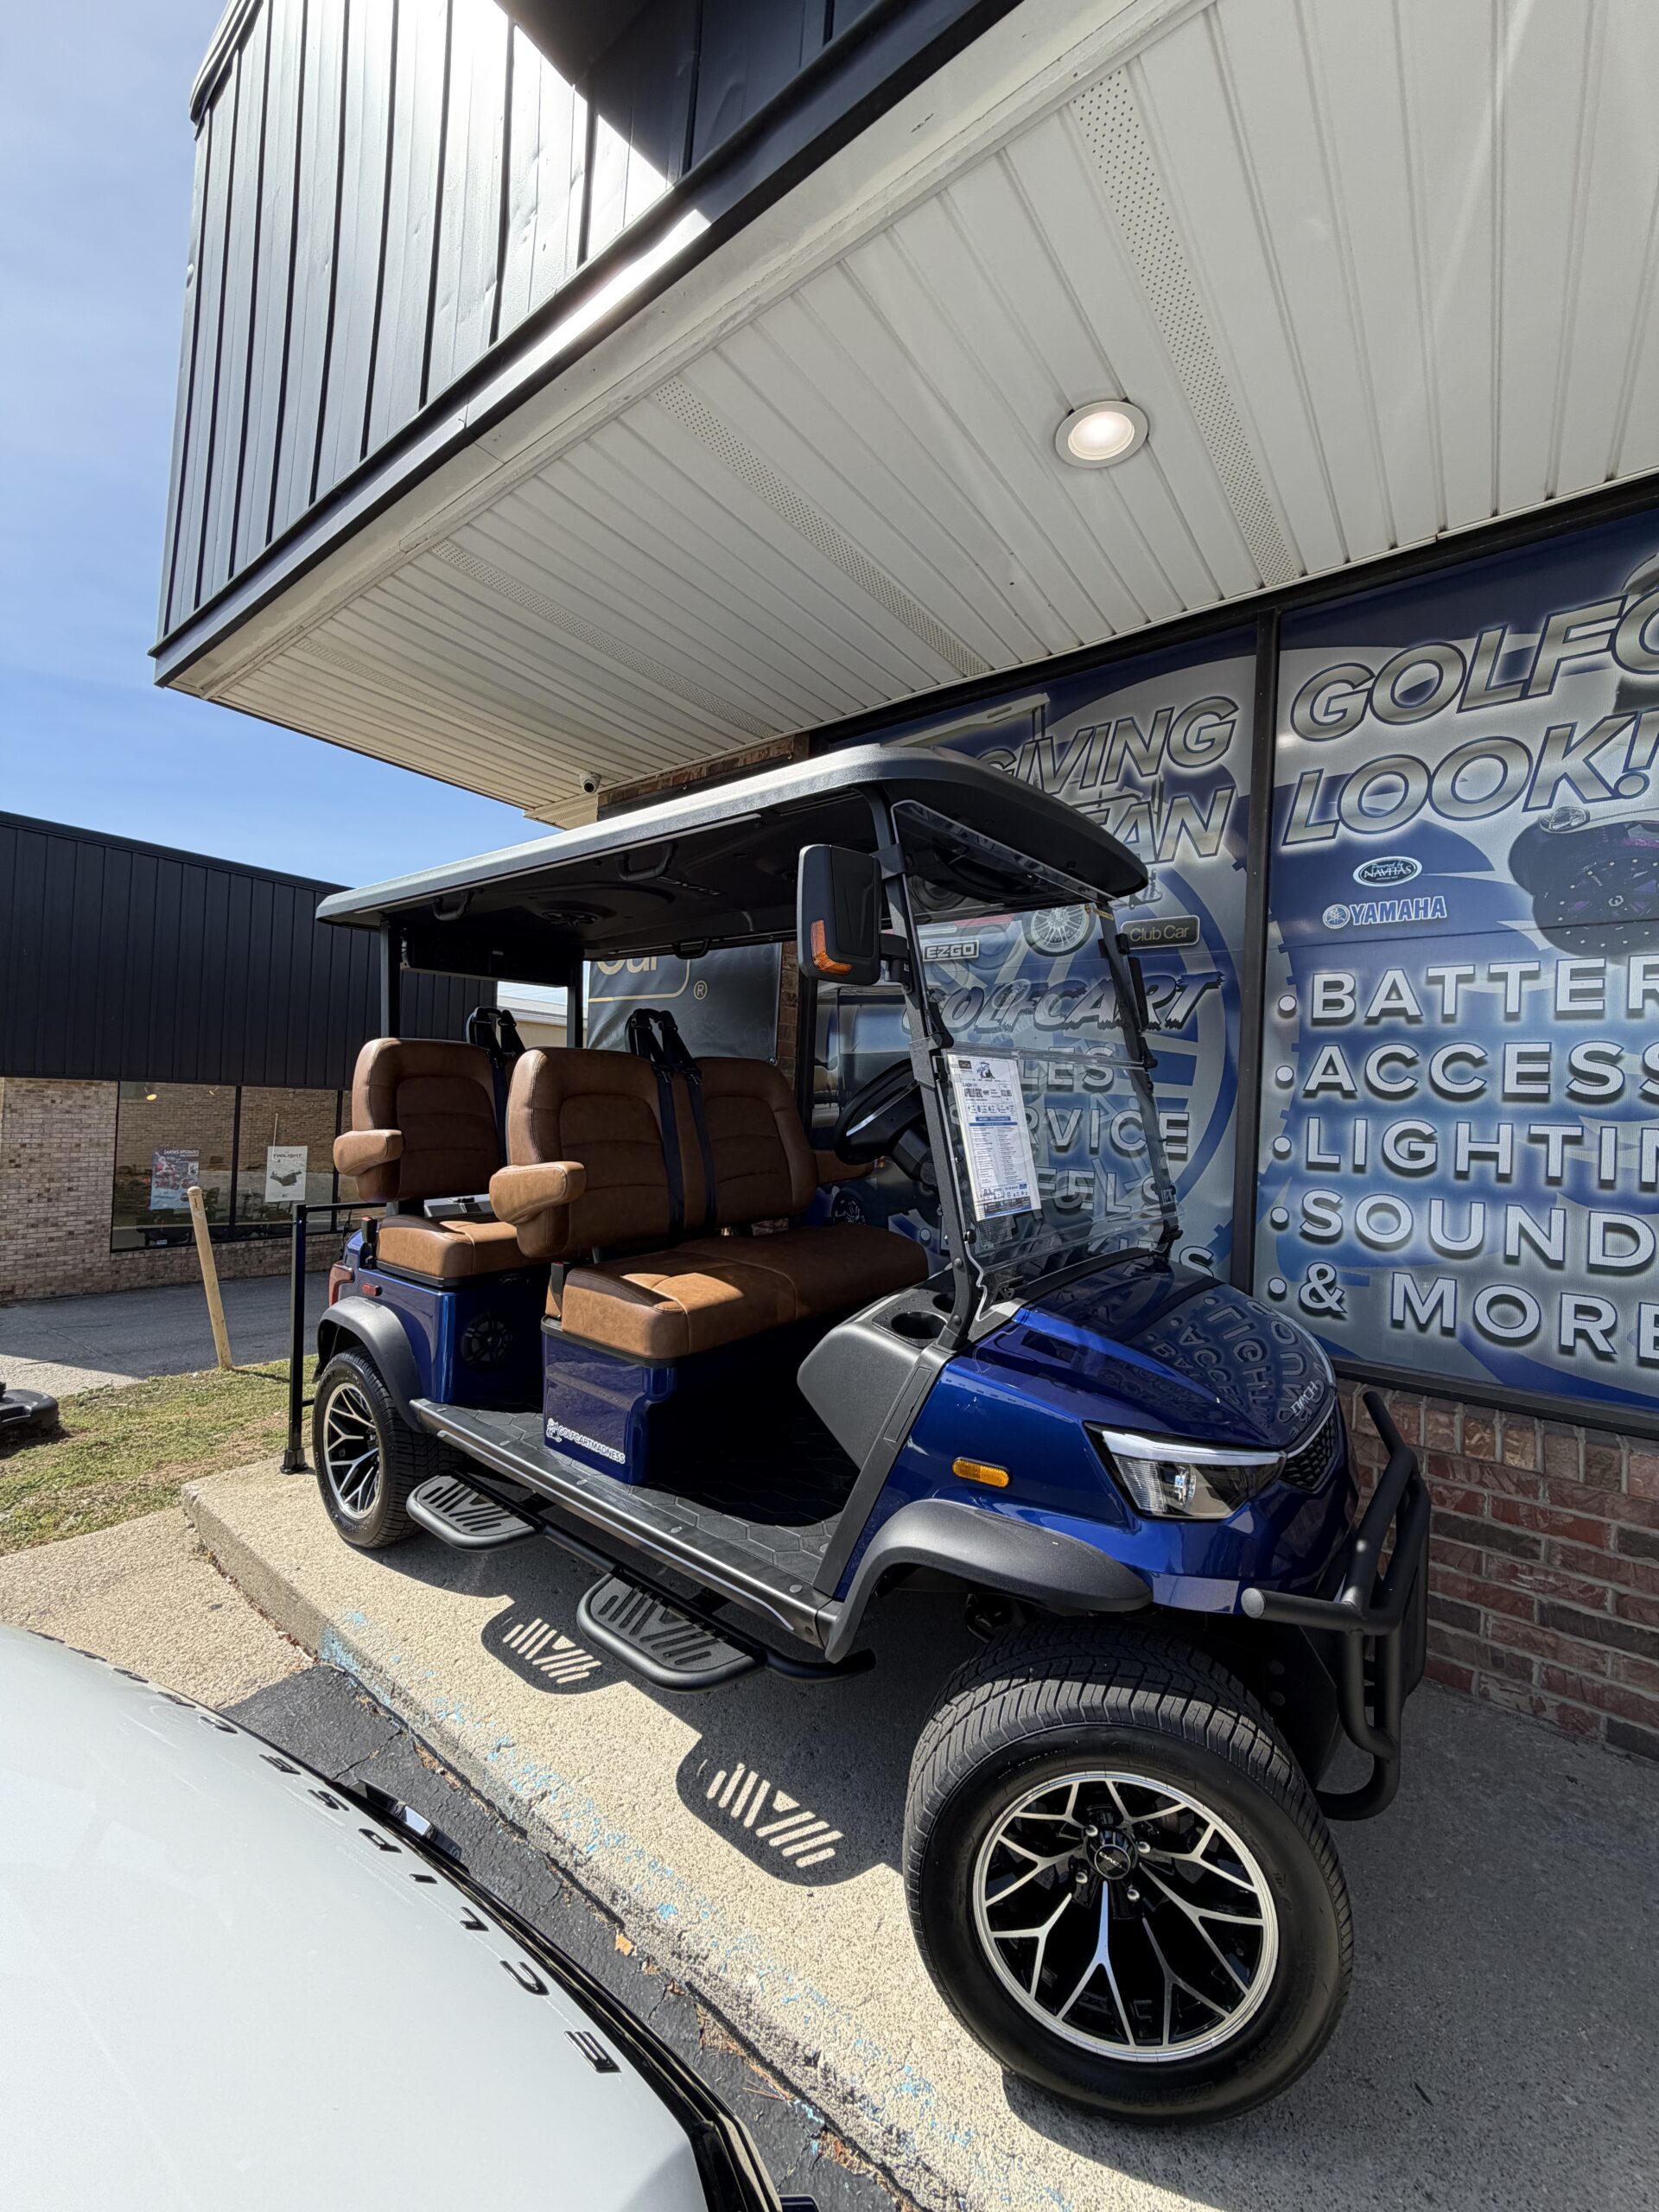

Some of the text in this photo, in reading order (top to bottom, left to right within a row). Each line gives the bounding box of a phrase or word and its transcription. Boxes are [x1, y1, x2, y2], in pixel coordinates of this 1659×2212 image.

[1281, 706, 1659, 846] LOOK!
[1363, 865, 1412, 879] NAVITAS
[1129, 925, 1190, 942] Club Car
[1349, 895, 1447, 925] YAMAHA
[902, 972, 1225, 1034] OLFCART
[1017, 1045, 1116, 1089] LES
[1300, 1188, 1656, 1268] SOUND
[1299, 1261, 1347, 1314] &
